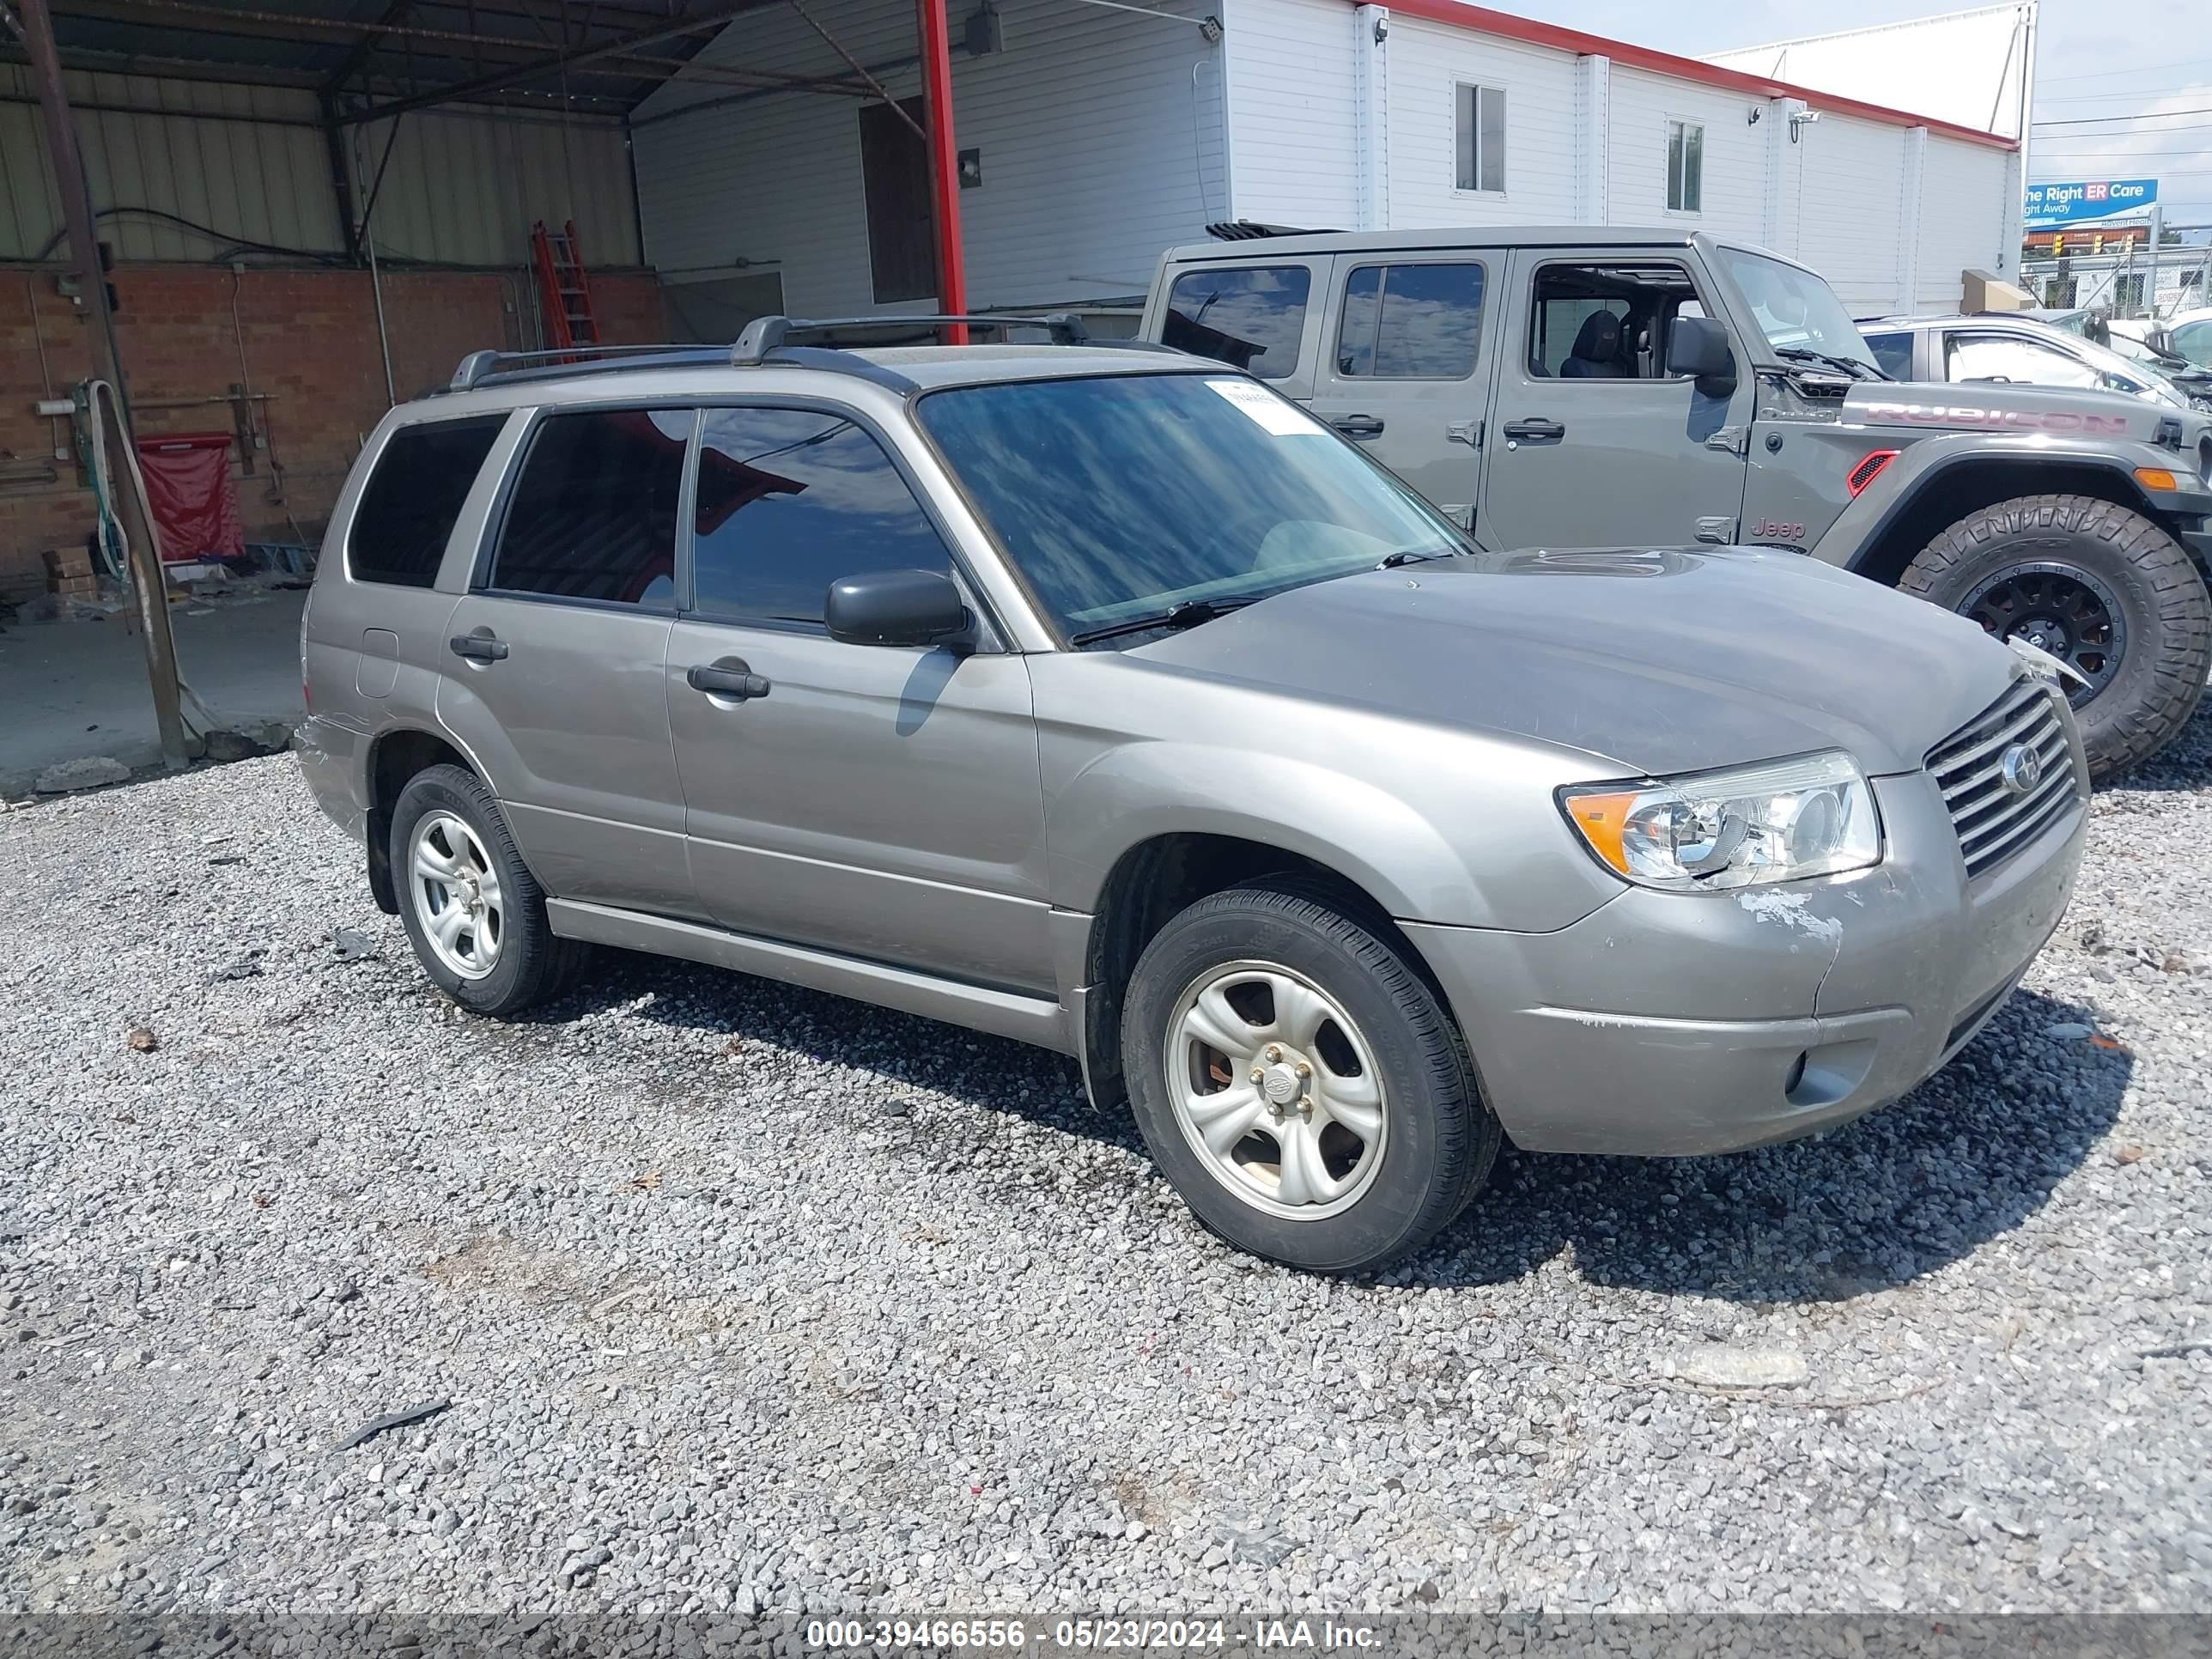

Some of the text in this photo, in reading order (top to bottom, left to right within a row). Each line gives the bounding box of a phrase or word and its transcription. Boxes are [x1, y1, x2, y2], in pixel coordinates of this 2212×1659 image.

[2025, 184, 2144, 204] he Right ER Care
[2024, 204, 2070, 216] ght Away
[1865, 403, 2127, 433] RUBICON
[1751, 517, 1806, 542] Jeep
